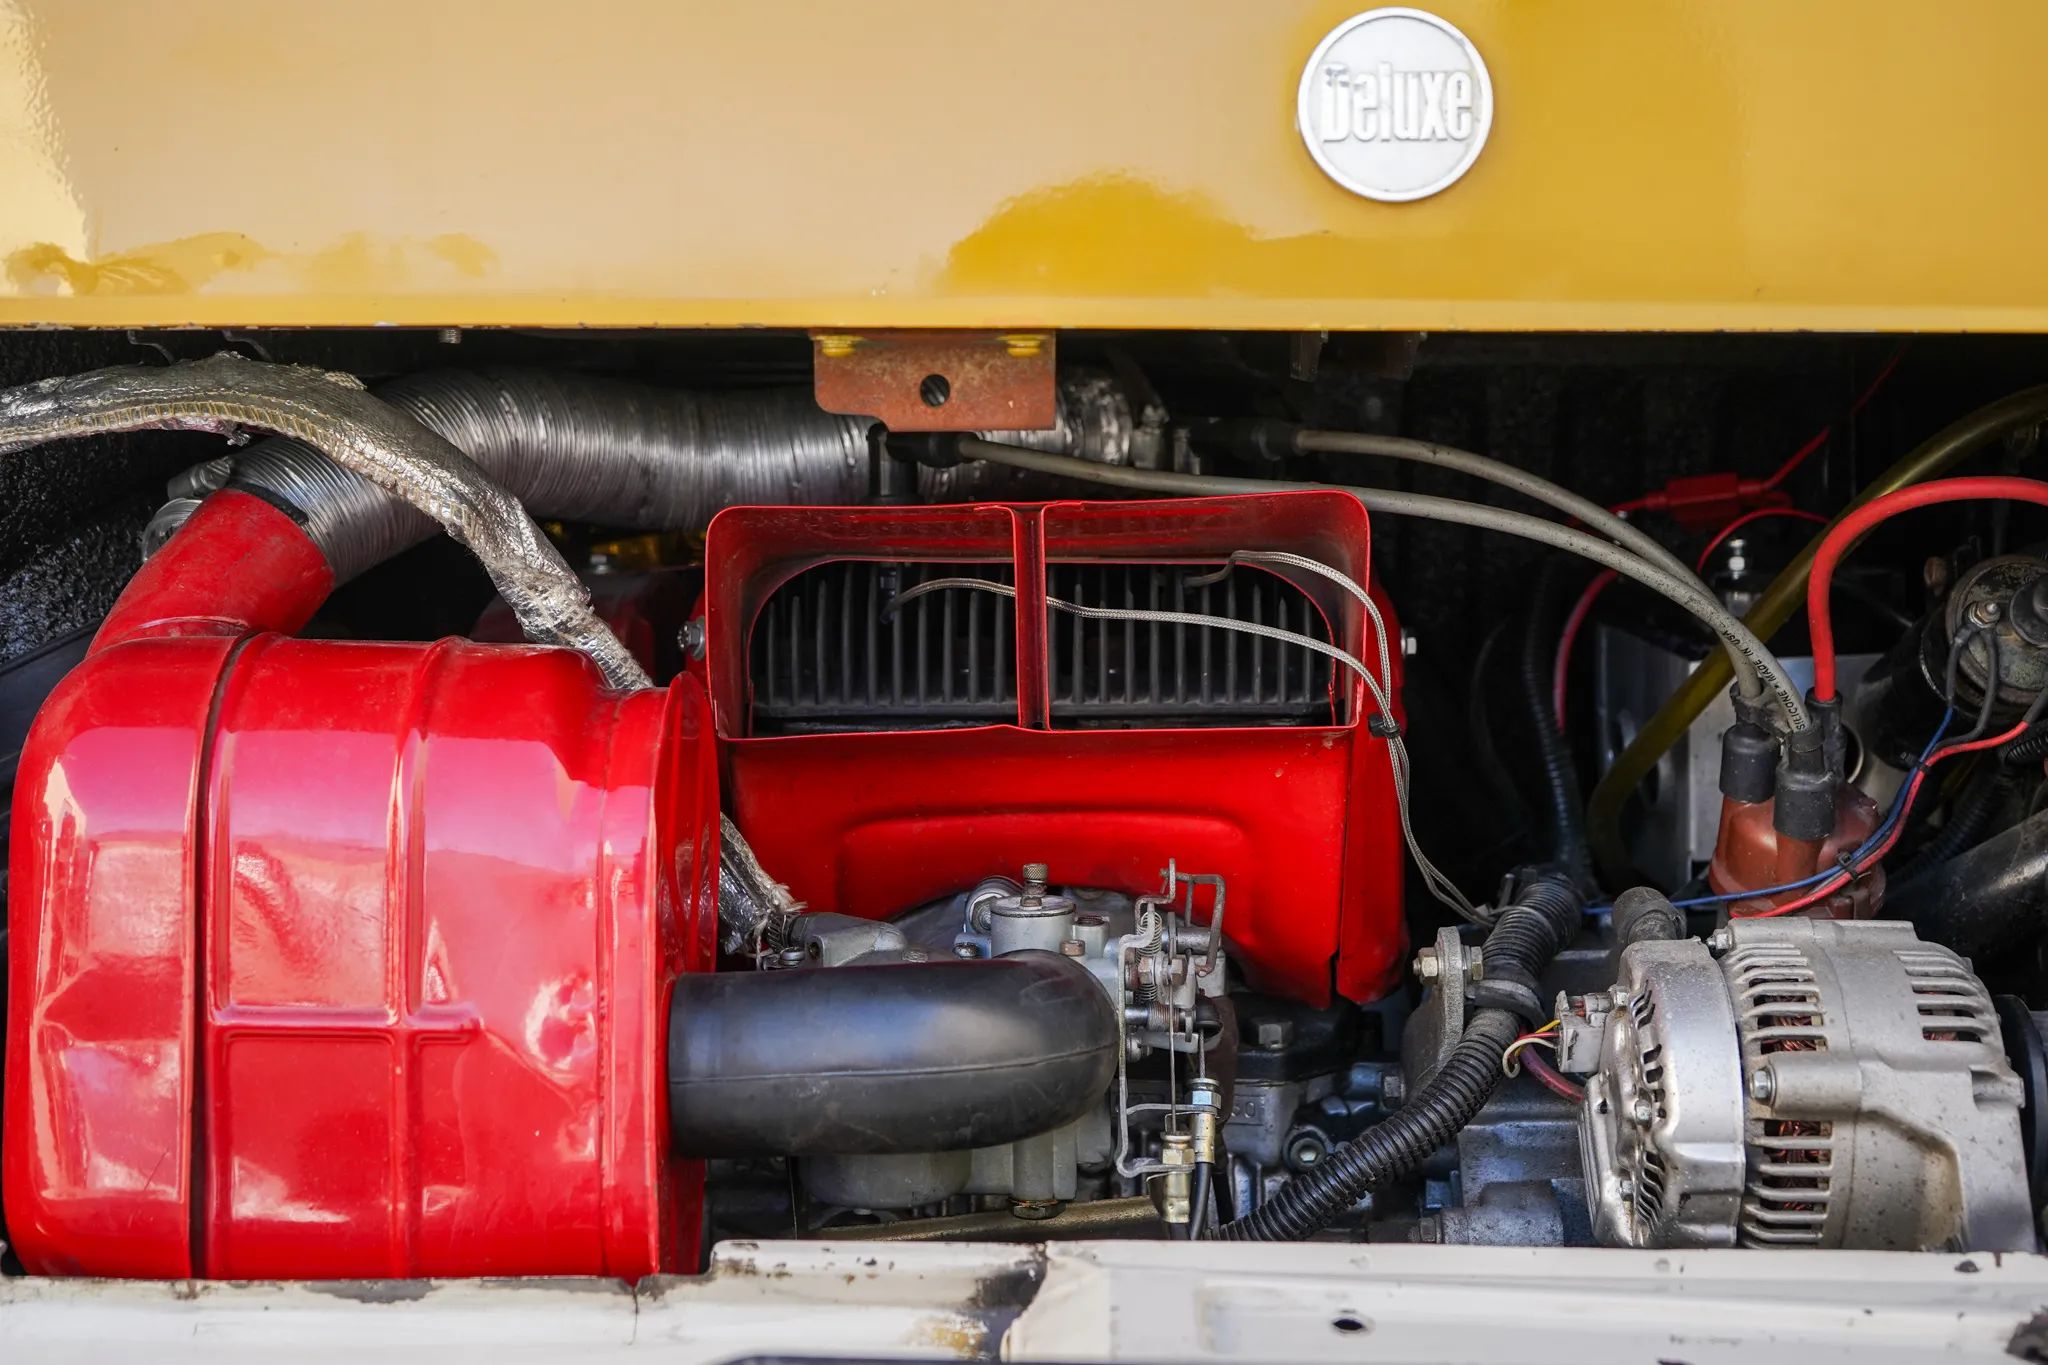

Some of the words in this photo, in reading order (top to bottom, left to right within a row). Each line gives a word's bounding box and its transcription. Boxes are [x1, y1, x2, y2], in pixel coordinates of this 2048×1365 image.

[1320, 62, 1473, 142] Deluxe
[1722, 630, 1741, 645] USA
[1742, 647, 1754, 657] IN
[1753, 659, 1777, 682] MADE
[1777, 690, 1806, 731] SILICONE
